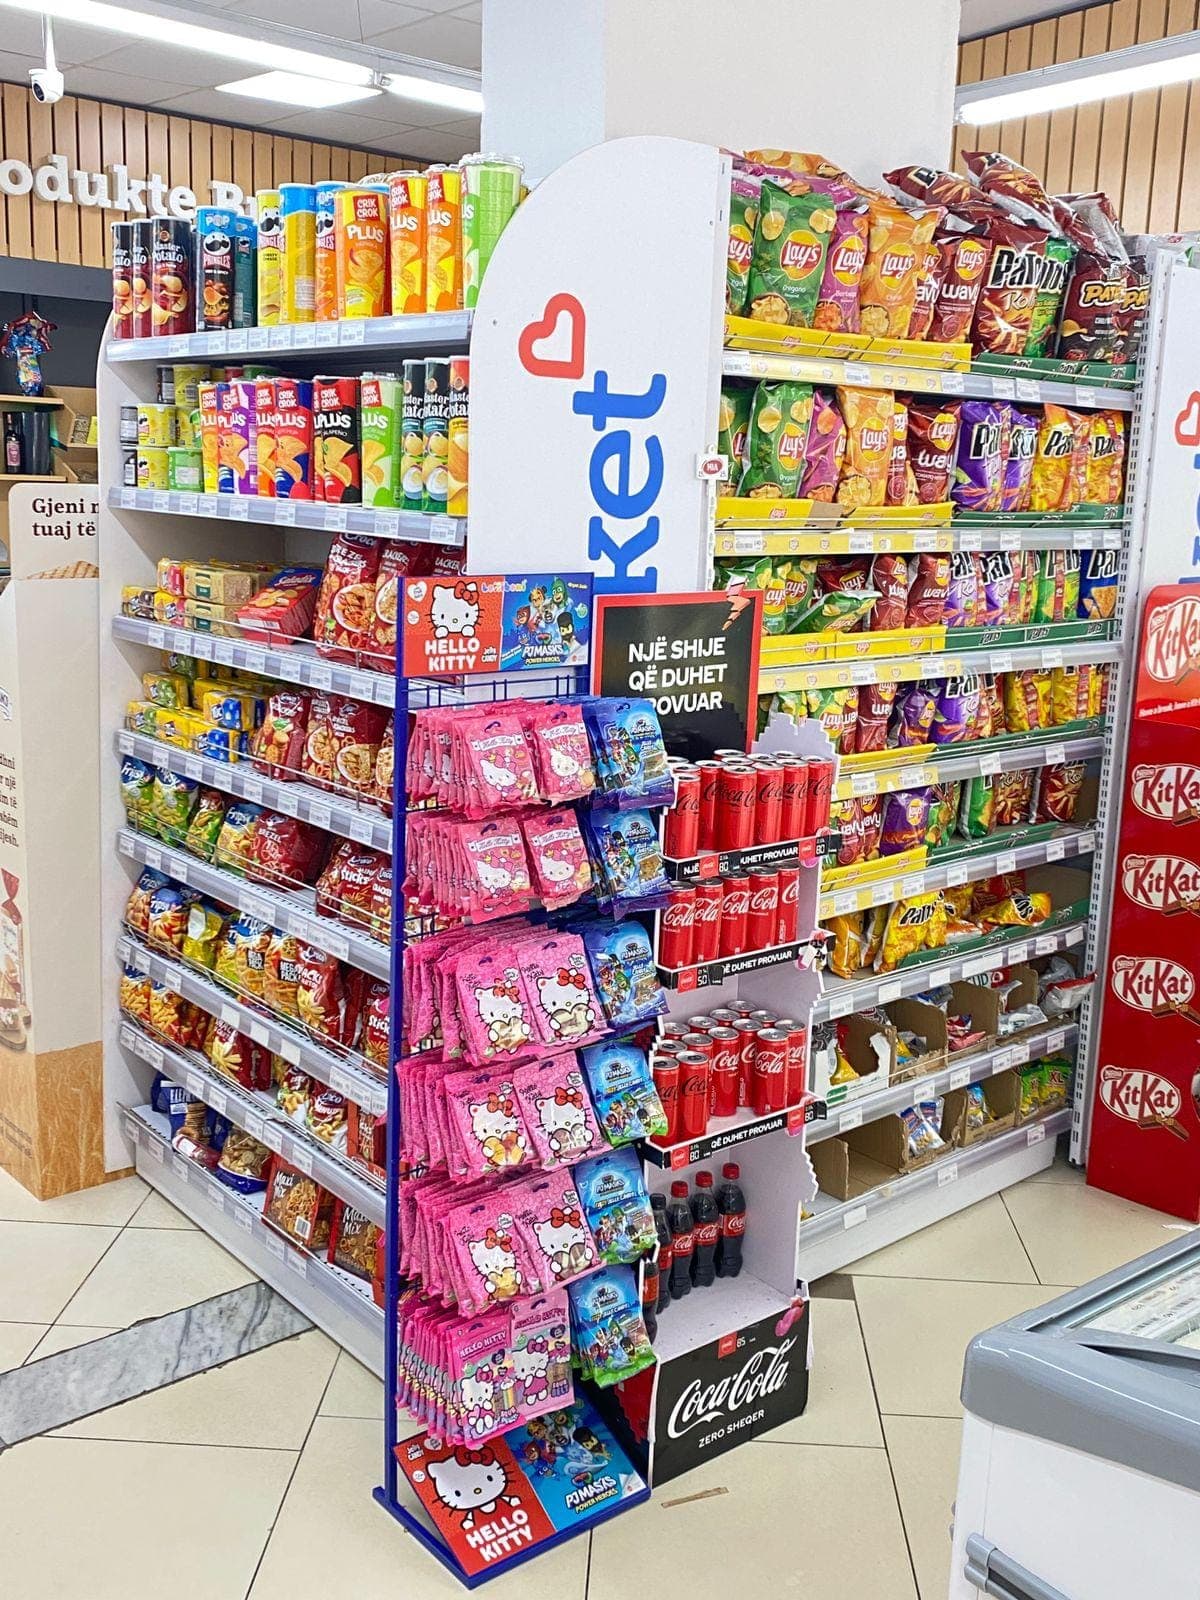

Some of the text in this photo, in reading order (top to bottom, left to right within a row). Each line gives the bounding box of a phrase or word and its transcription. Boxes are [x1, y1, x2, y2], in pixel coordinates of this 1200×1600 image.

[357, 198, 377, 209] CRIK
[357, 208, 379, 219] CROK
[785, 240, 821, 267] Lay's
[881, 252, 915, 279] Lay's
[321, 387, 337, 399] CRIK
[321, 398, 341, 408] CROK
[780, 433, 805, 456] Lay's
[861, 430, 888, 452] Lay's
[32, 498, 86, 517] Gjeni
[32, 520, 97, 541] tuaj të
[424, 636, 481, 656] HELLO
[628, 636, 727, 663] NJË SHIJE
[428, 654, 477, 672] KITTY
[628, 662, 728, 691] QË DUHET
[763, 845, 799, 862] PROVUAR
[815, 843, 826, 855] 80
[719, 861, 729, 873] 80
[730, 958, 758, 973] DUHET
[757, 950, 793, 967] PROVUAR
[1121, 961, 1189, 1006] KitKat
[1109, 1072, 1176, 1118] KitKat
[804, 1109, 814, 1122] 80
[722, 1128, 749, 1146] DUHET
[749, 1119, 783, 1137] PROVUAR
[690, 1149, 700, 1162] 80
[484, 1331, 507, 1346] KITTY
[667, 1336, 798, 1439] Coca-Cola
[698, 1409, 766, 1449] ZERO SHEQER
[465, 1508, 530, 1549] HELLO
[479, 1525, 534, 1563] KITTY
